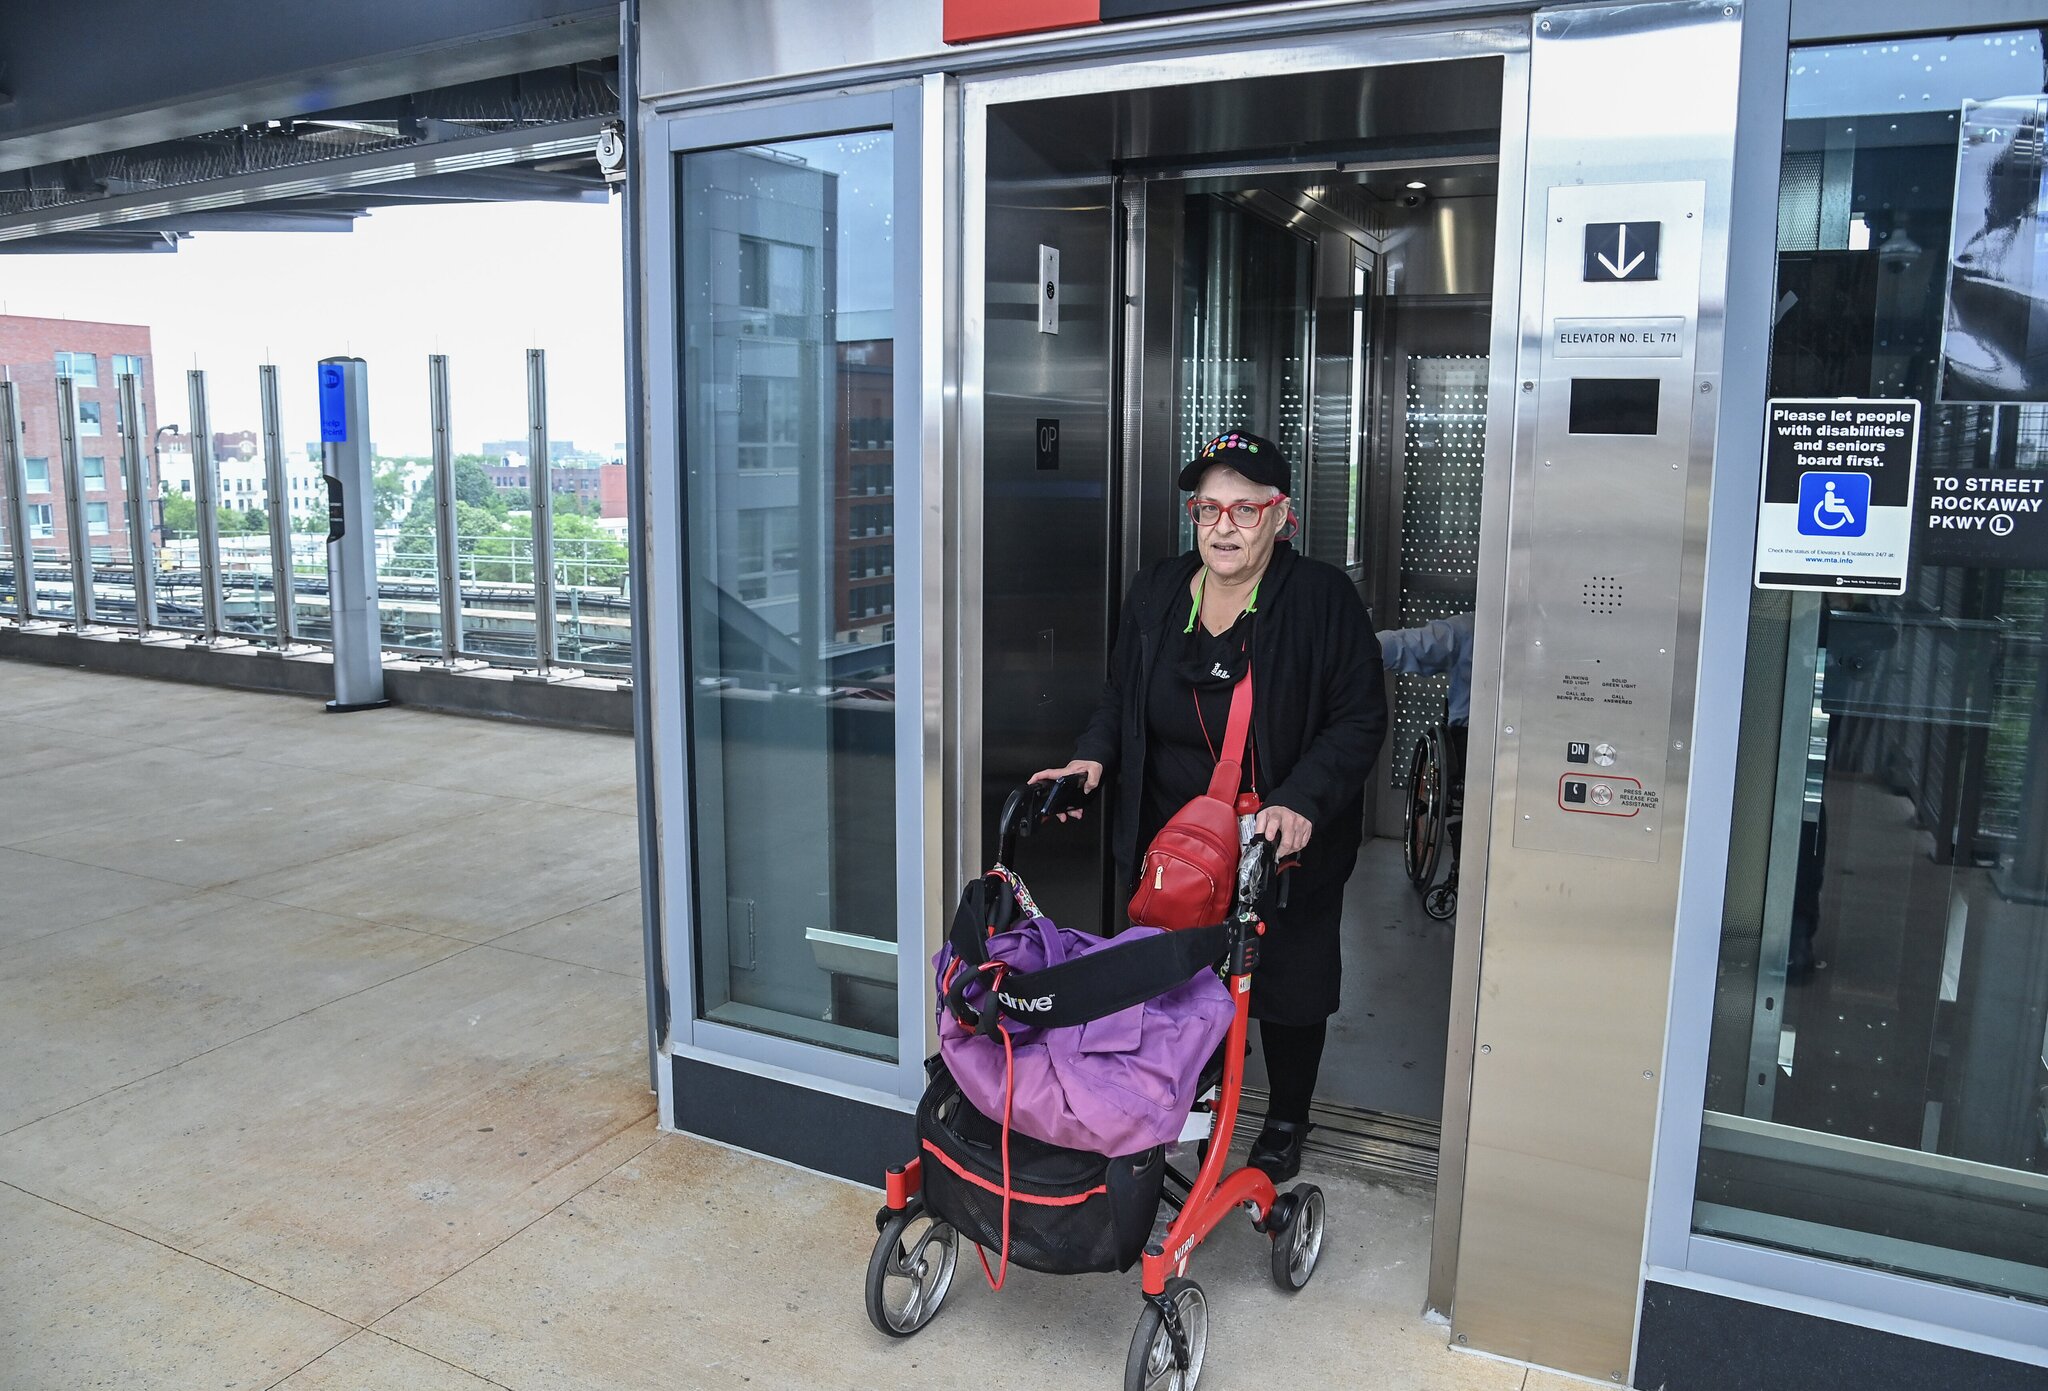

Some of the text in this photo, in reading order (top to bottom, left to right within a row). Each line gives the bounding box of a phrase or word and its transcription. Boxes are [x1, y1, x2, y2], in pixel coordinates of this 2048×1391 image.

[1560, 332, 1677, 343] ELEVATOR NO. EL 771
[1774, 409, 1911, 424] Please let people
[1777, 425, 1905, 437] with disabilities
[1040, 426, 1057, 452] OP
[1793, 439, 1886, 452] and seniors
[1797, 454, 1884, 467] board first.
[1933, 477, 2044, 493] TO STREET
[1930, 496, 2043, 513] ROCKAWAY
[1929, 515, 1986, 530] PKWY
[1571, 743, 1586, 755] DN
[1620, 794, 1645, 802] RELEASE
[1623, 788, 1642, 796] PRESS
[1621, 800, 1657, 809] ASSISTANCE
[998, 992, 1053, 1012] drive
